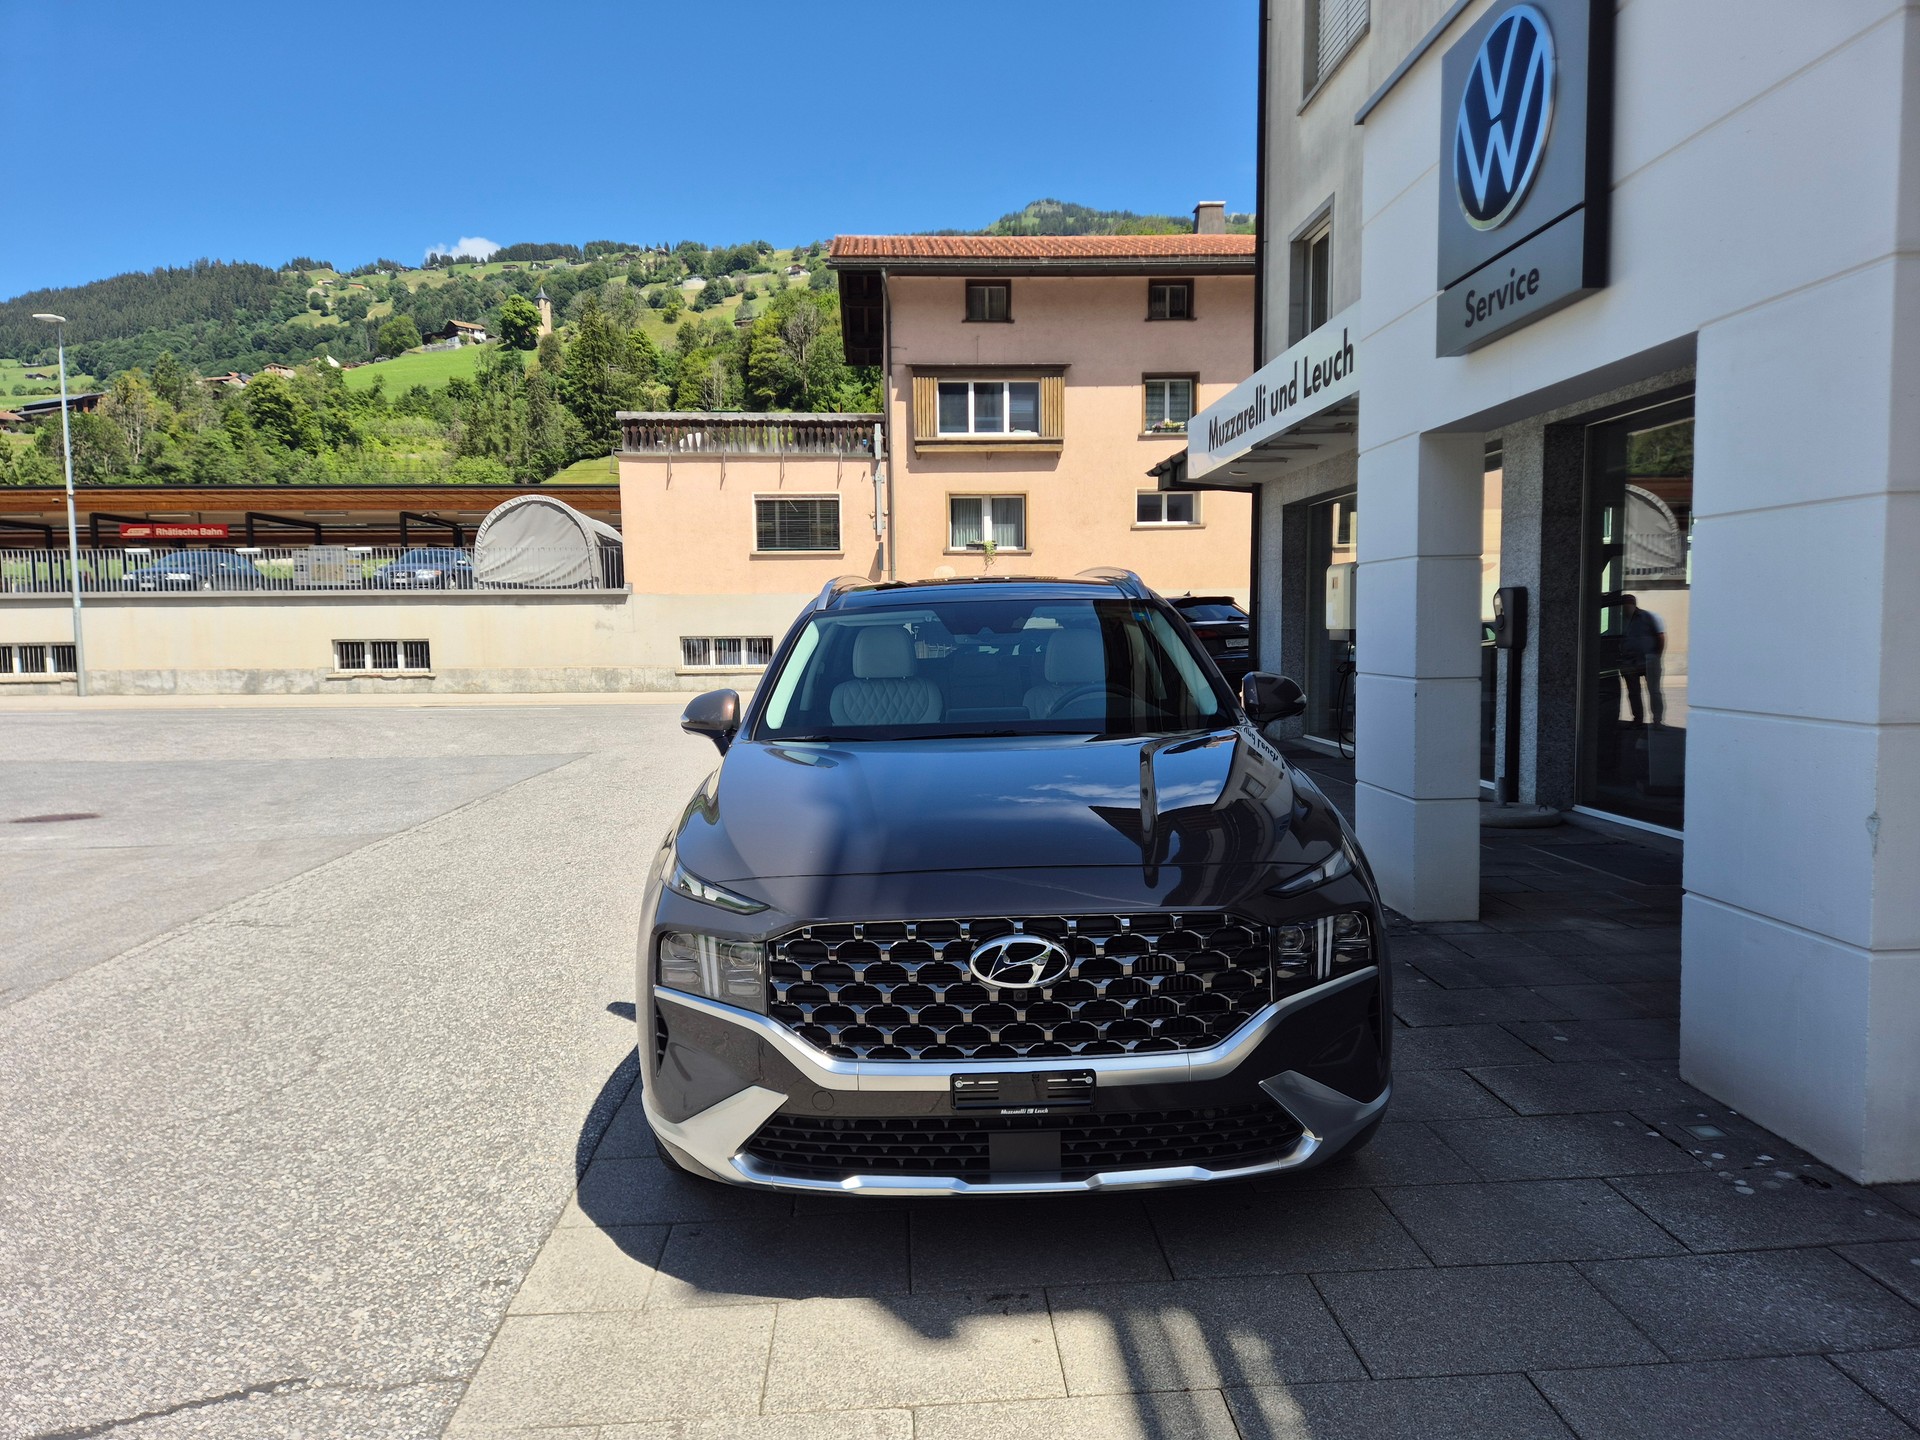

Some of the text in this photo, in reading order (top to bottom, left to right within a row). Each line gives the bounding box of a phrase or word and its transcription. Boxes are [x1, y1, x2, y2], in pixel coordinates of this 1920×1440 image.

[1464, 267, 1540, 328] Service
[1208, 327, 1354, 453] Muzzarelli und Leuch
[155, 527, 224, 536] Rhätische Bahn
